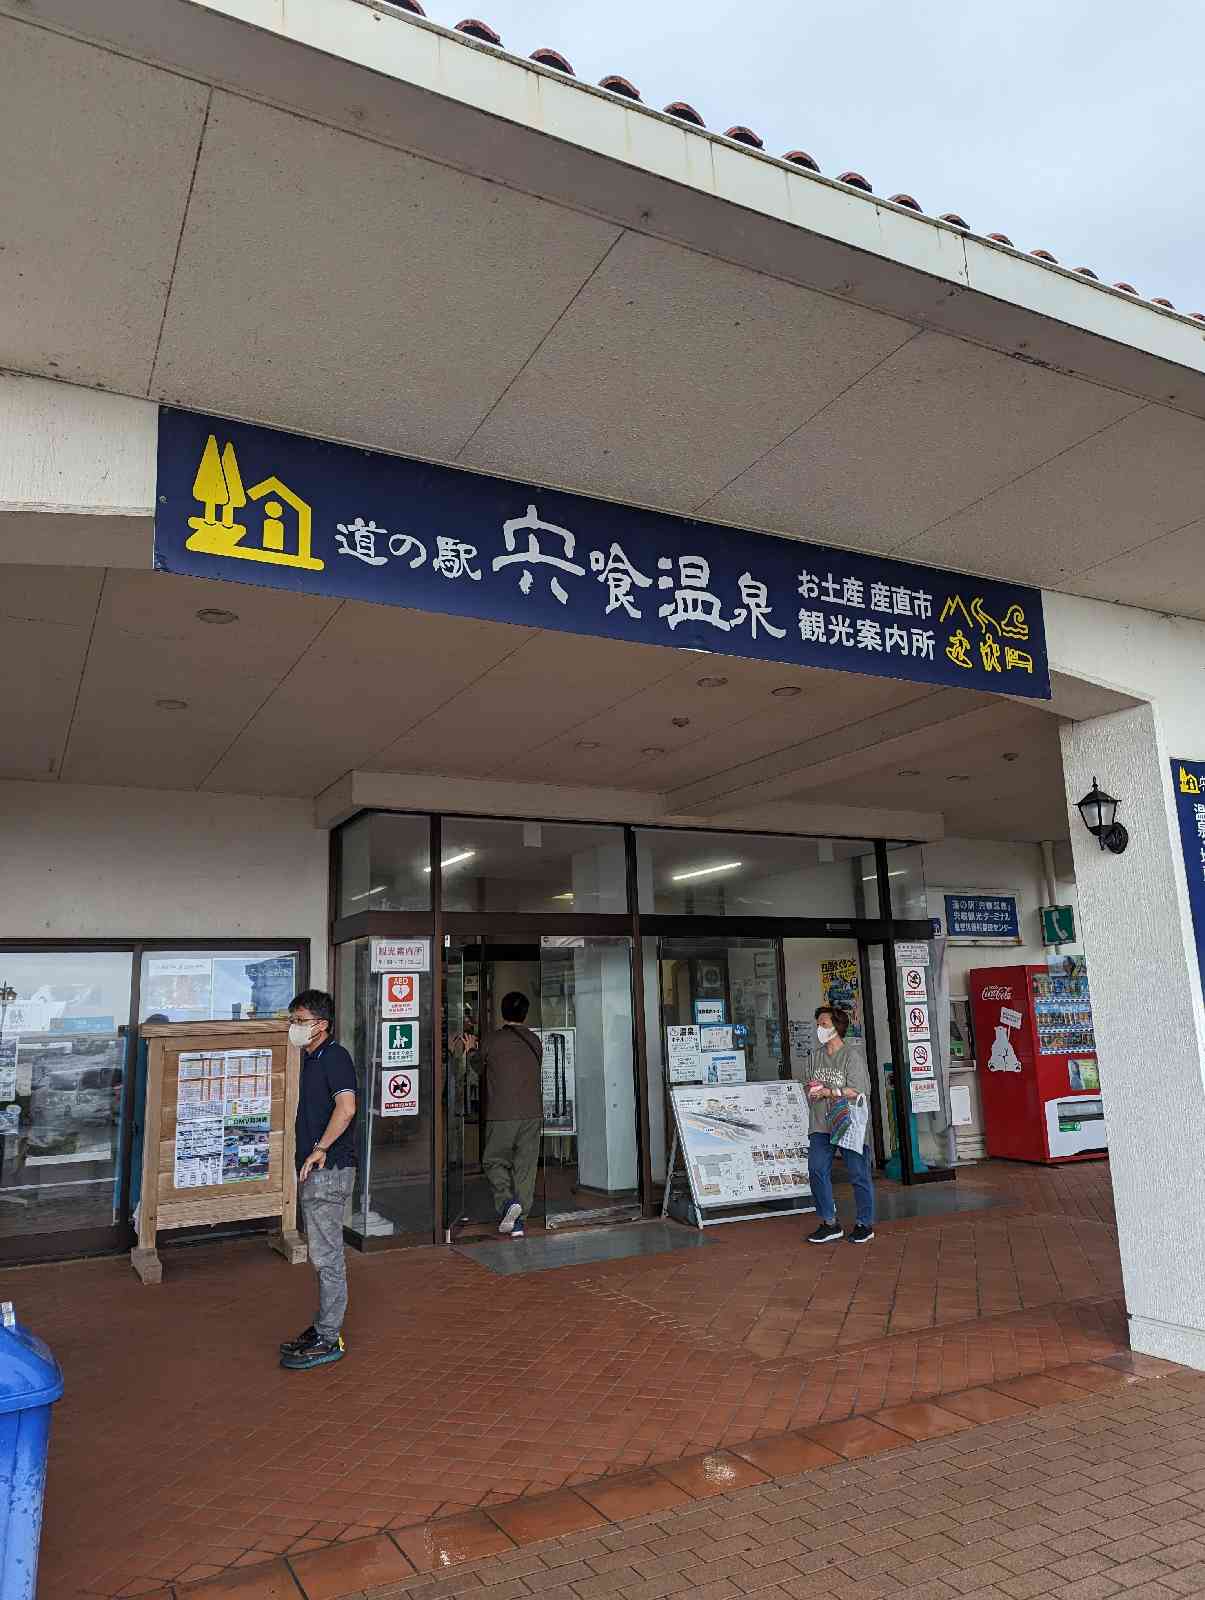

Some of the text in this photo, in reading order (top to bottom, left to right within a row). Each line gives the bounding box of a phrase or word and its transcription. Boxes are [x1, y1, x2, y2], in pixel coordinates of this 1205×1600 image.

[335, 504, 787, 639] 道の駅 宍喰温泉
[798, 569, 933, 621] お土産 産直市
[798, 608, 936, 661] 観光案内所
[393, 977, 409, 985] AED
